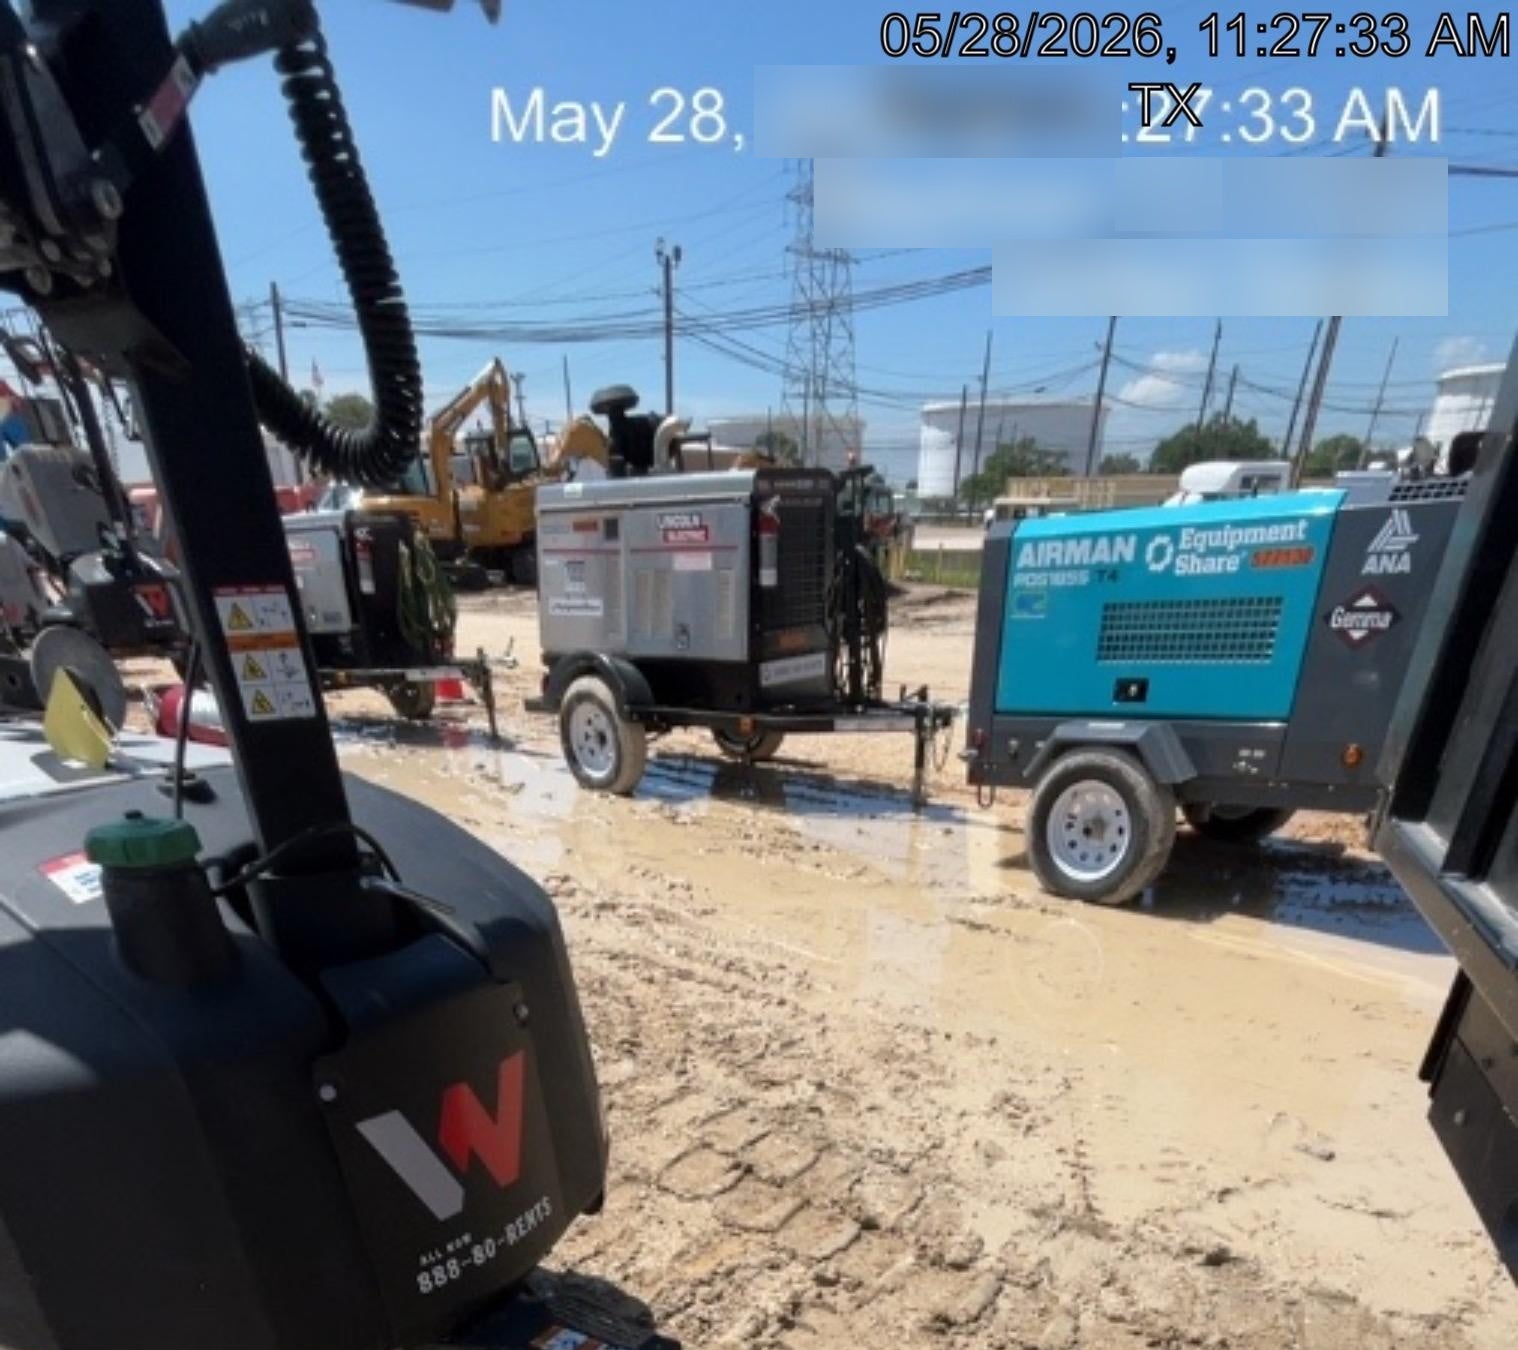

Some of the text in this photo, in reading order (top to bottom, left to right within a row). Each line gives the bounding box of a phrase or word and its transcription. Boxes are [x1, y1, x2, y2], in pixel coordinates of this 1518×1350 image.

[1179, 519, 1308, 552] Equipment
[1016, 534, 1136, 569] AIRMAN
[1175, 554, 1240, 576] Share
[1361, 551, 1411, 575] ANA
[1330, 605, 1392, 629] Gemma
[416, 1196, 552, 1294] 888-80-RENTS
